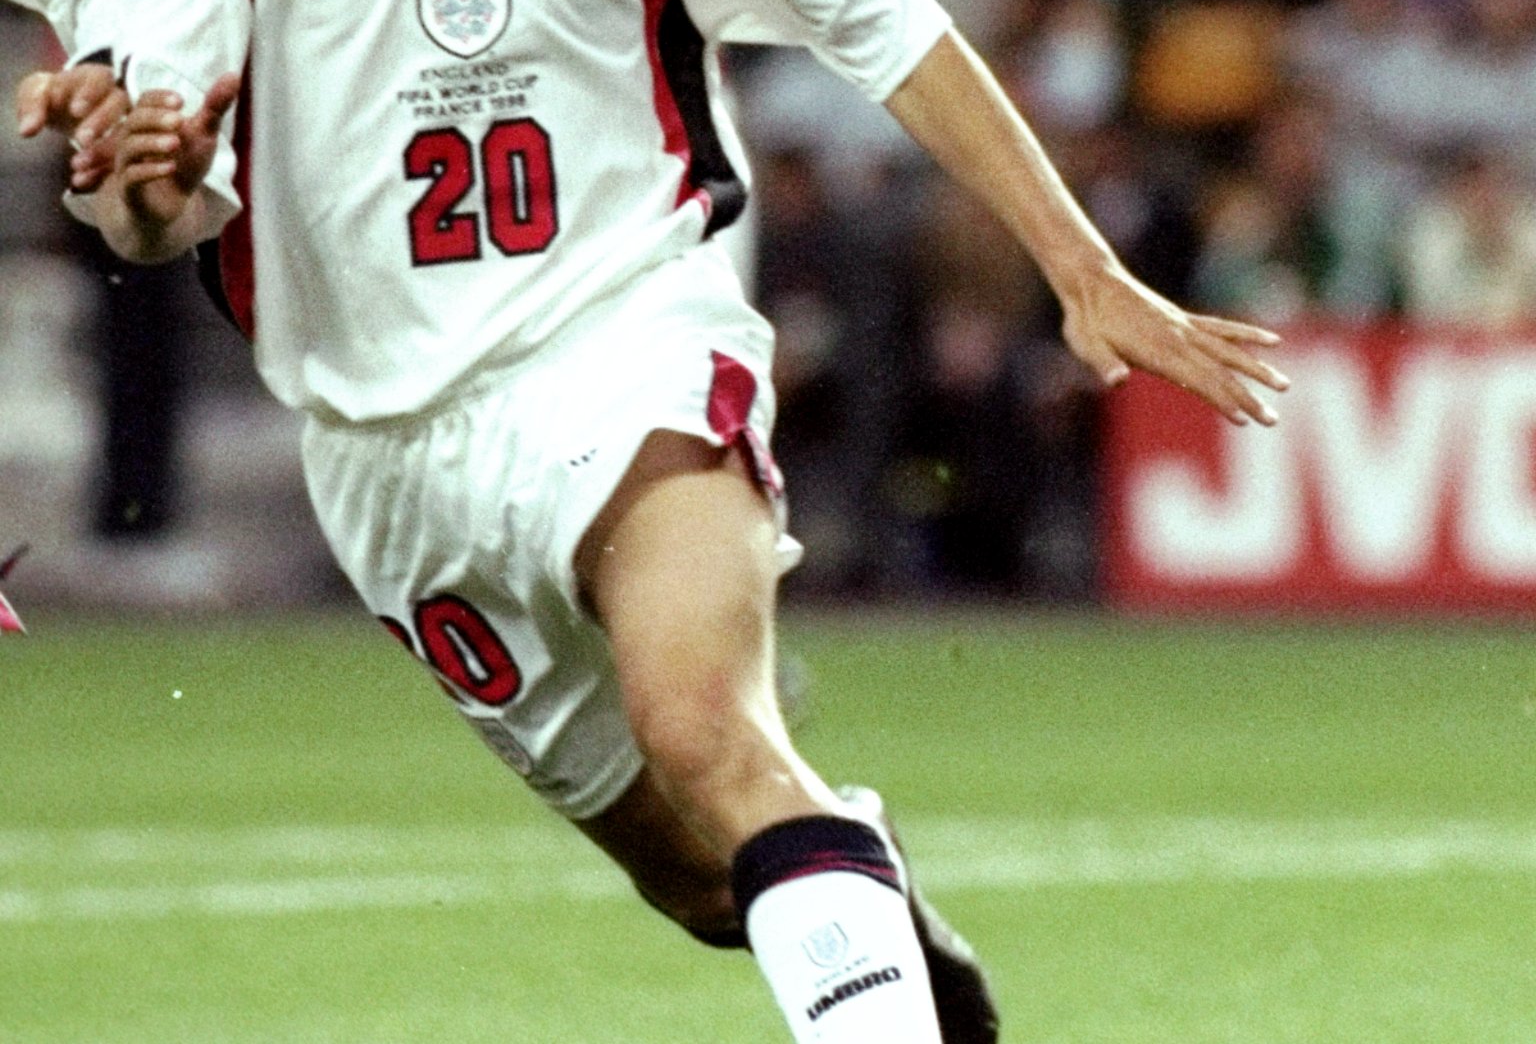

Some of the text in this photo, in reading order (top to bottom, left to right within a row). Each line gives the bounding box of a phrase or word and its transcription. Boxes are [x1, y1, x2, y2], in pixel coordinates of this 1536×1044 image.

[404, 116, 560, 268] 20
[378, 593, 522, 707] 0
[806, 966, 902, 1022] UMBRO
